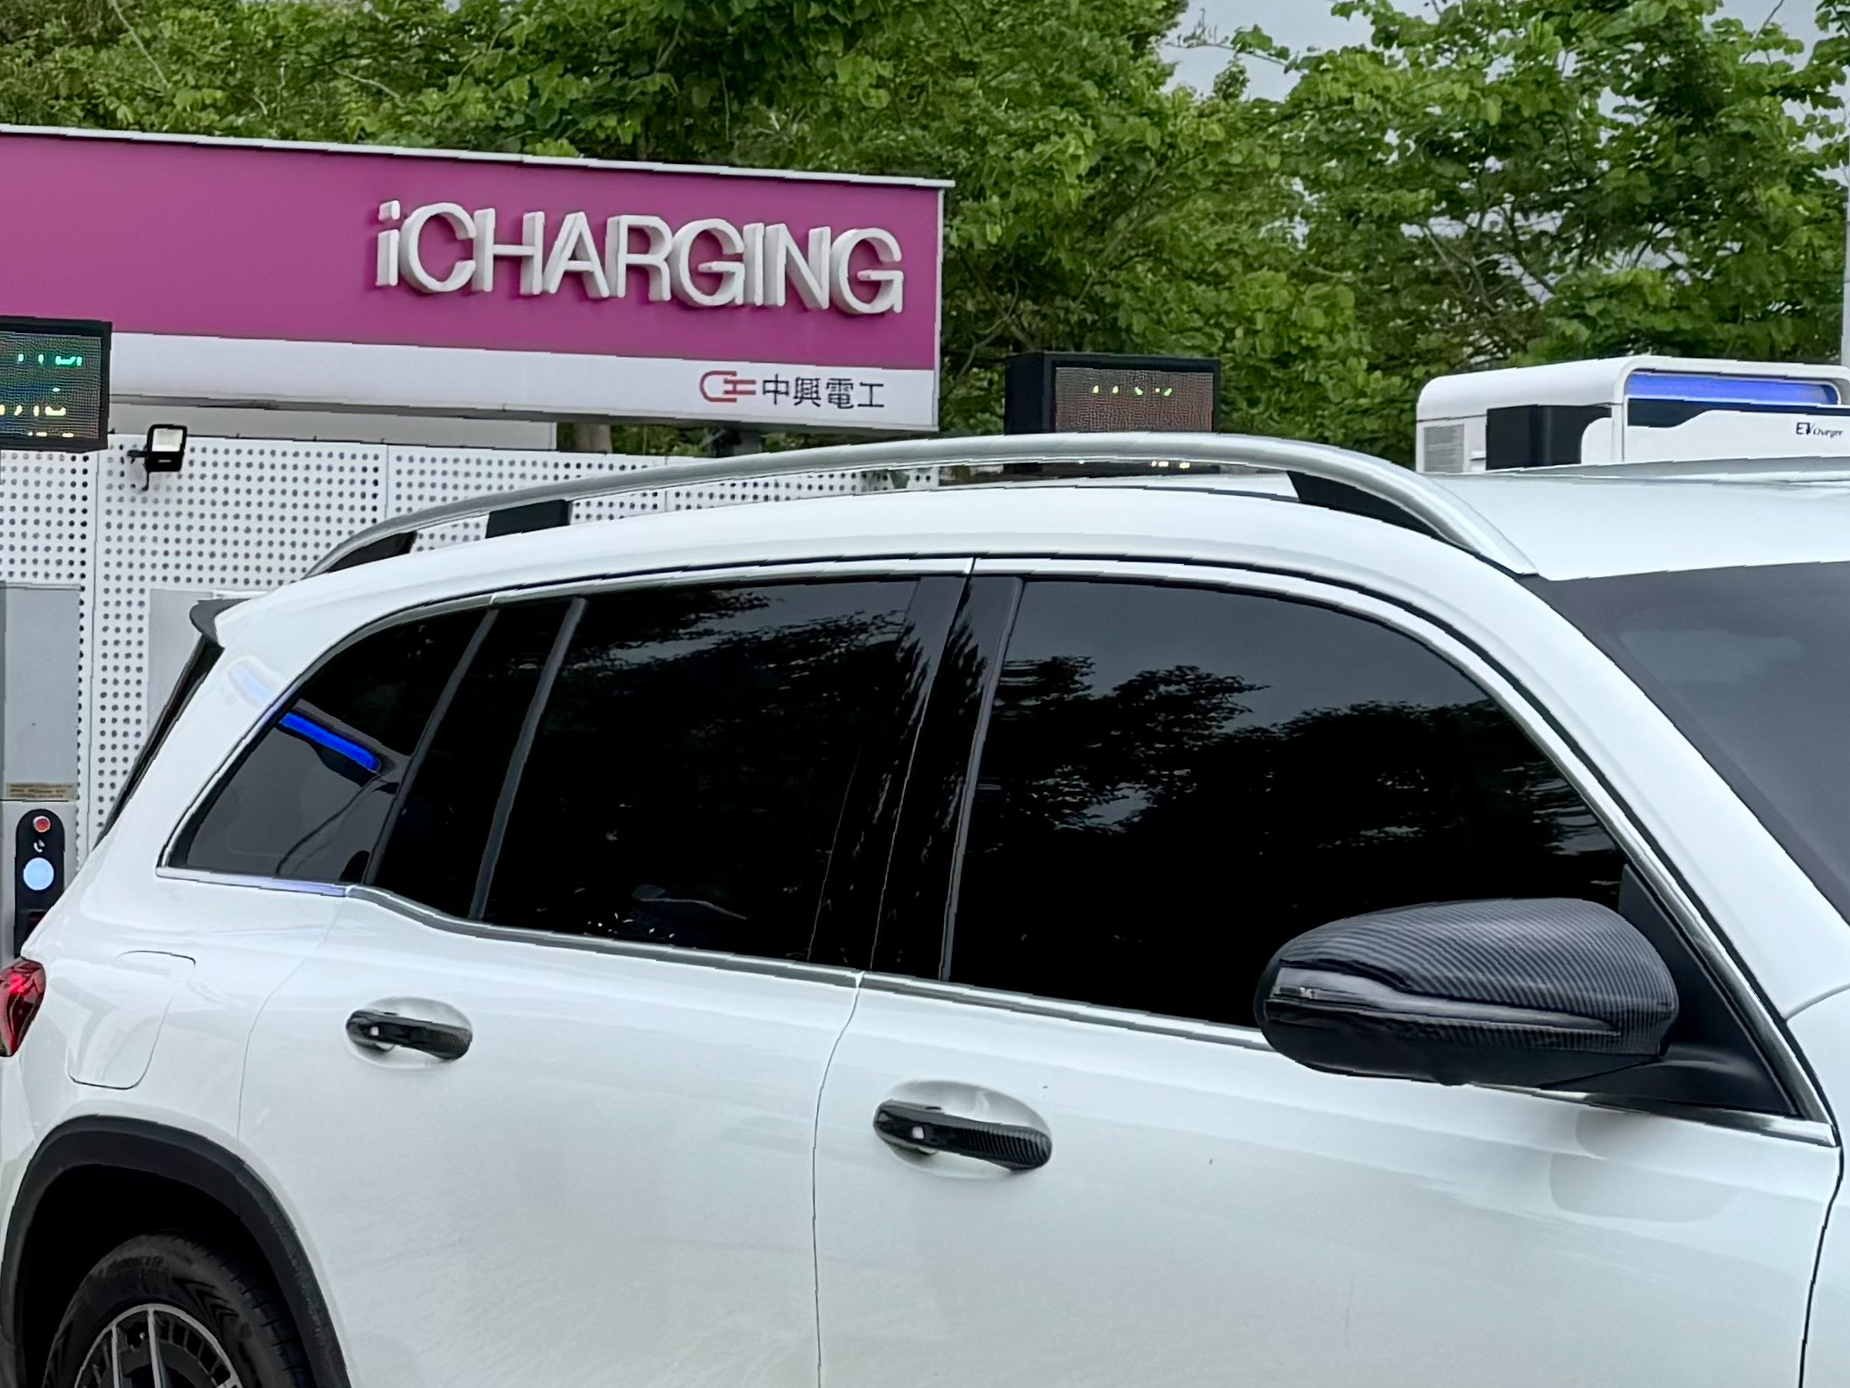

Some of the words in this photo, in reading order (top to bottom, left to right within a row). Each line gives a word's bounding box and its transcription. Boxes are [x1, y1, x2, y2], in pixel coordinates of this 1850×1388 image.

[376, 199, 904, 314] iCHARGING
[761, 373, 885, 410] 中興電工
